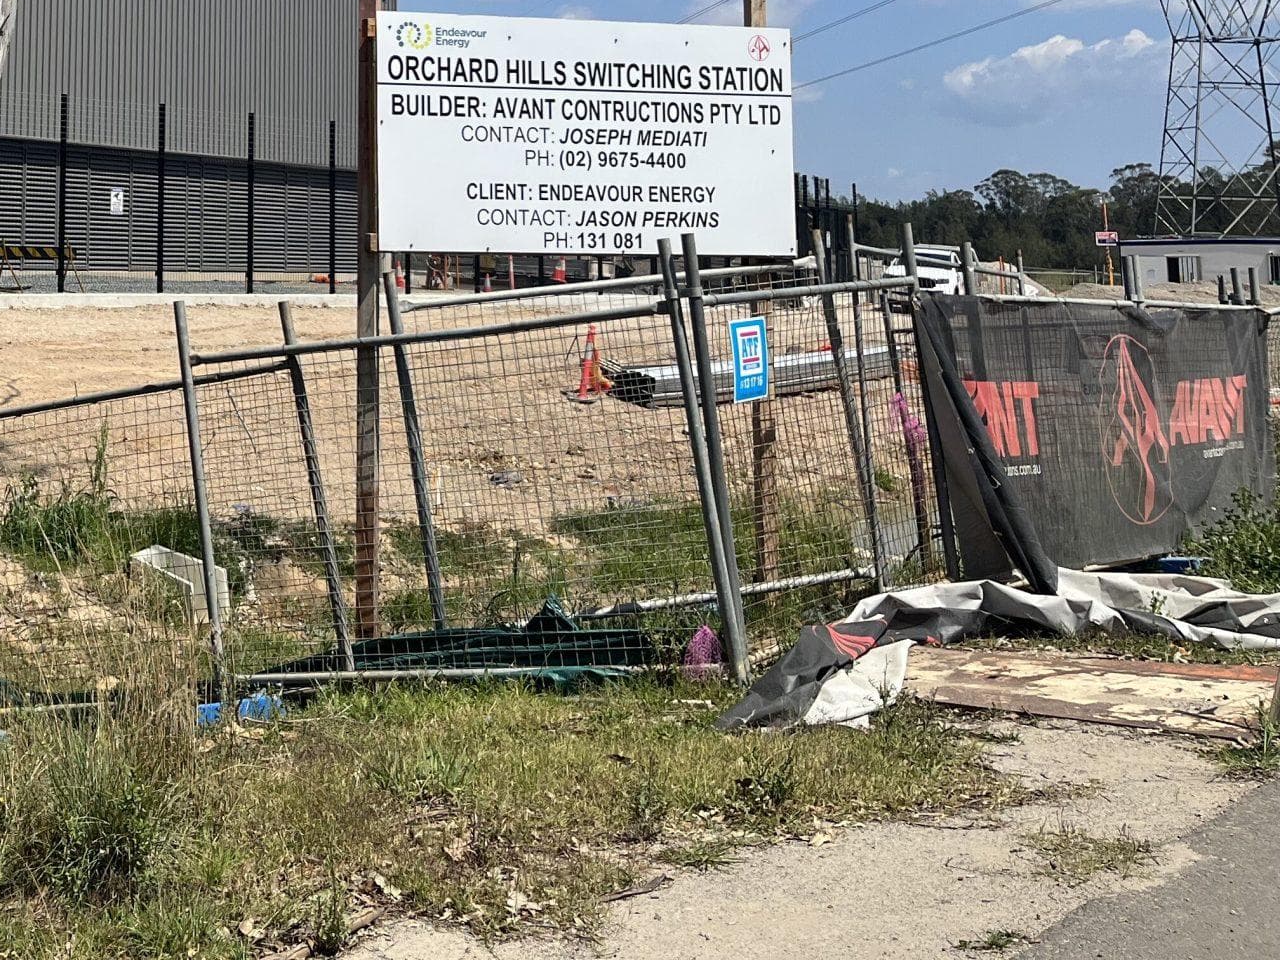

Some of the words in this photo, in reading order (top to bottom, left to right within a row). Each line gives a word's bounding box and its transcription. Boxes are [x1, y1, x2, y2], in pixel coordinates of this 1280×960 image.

[435, 27, 487, 38] Endeavour
[435, 37, 470, 48] Energy
[388, 55, 498, 83] ORCHARD
[506, 59, 567, 86] HILLS
[573, 61, 692, 90] SWITCHING
[698, 66, 783, 92] STATION
[391, 94, 487, 118] BUILDER:
[493, 97, 556, 120] AVANT
[561, 99, 704, 123] CONTRUCTIONS
[710, 103, 743, 125] PTY
[748, 104, 781, 125] LTD
[461, 125, 555, 144] CONTACT:
[559, 128, 632, 146] JOSEPH
[636, 130, 708, 147] MEDIATI
[524, 150, 555, 167] PH:
[559, 150, 593, 171] (02)
[598, 152, 686, 169] 9675-4400
[466, 183, 533, 201] CLIENT:
[538, 184, 643, 202] ENDEAVOUR
[648, 186, 716, 203] ENERGY
[477, 208, 571, 226] CONTACT:
[575, 210, 637, 227] JASON
[642, 211, 720, 228] PERKINS
[543, 231, 573, 249] PH:
[577, 233, 607, 249] 131
[613, 233, 643, 249] 081
[741, 337, 758, 357] ATF
[1170, 374, 1248, 446] AVANT
